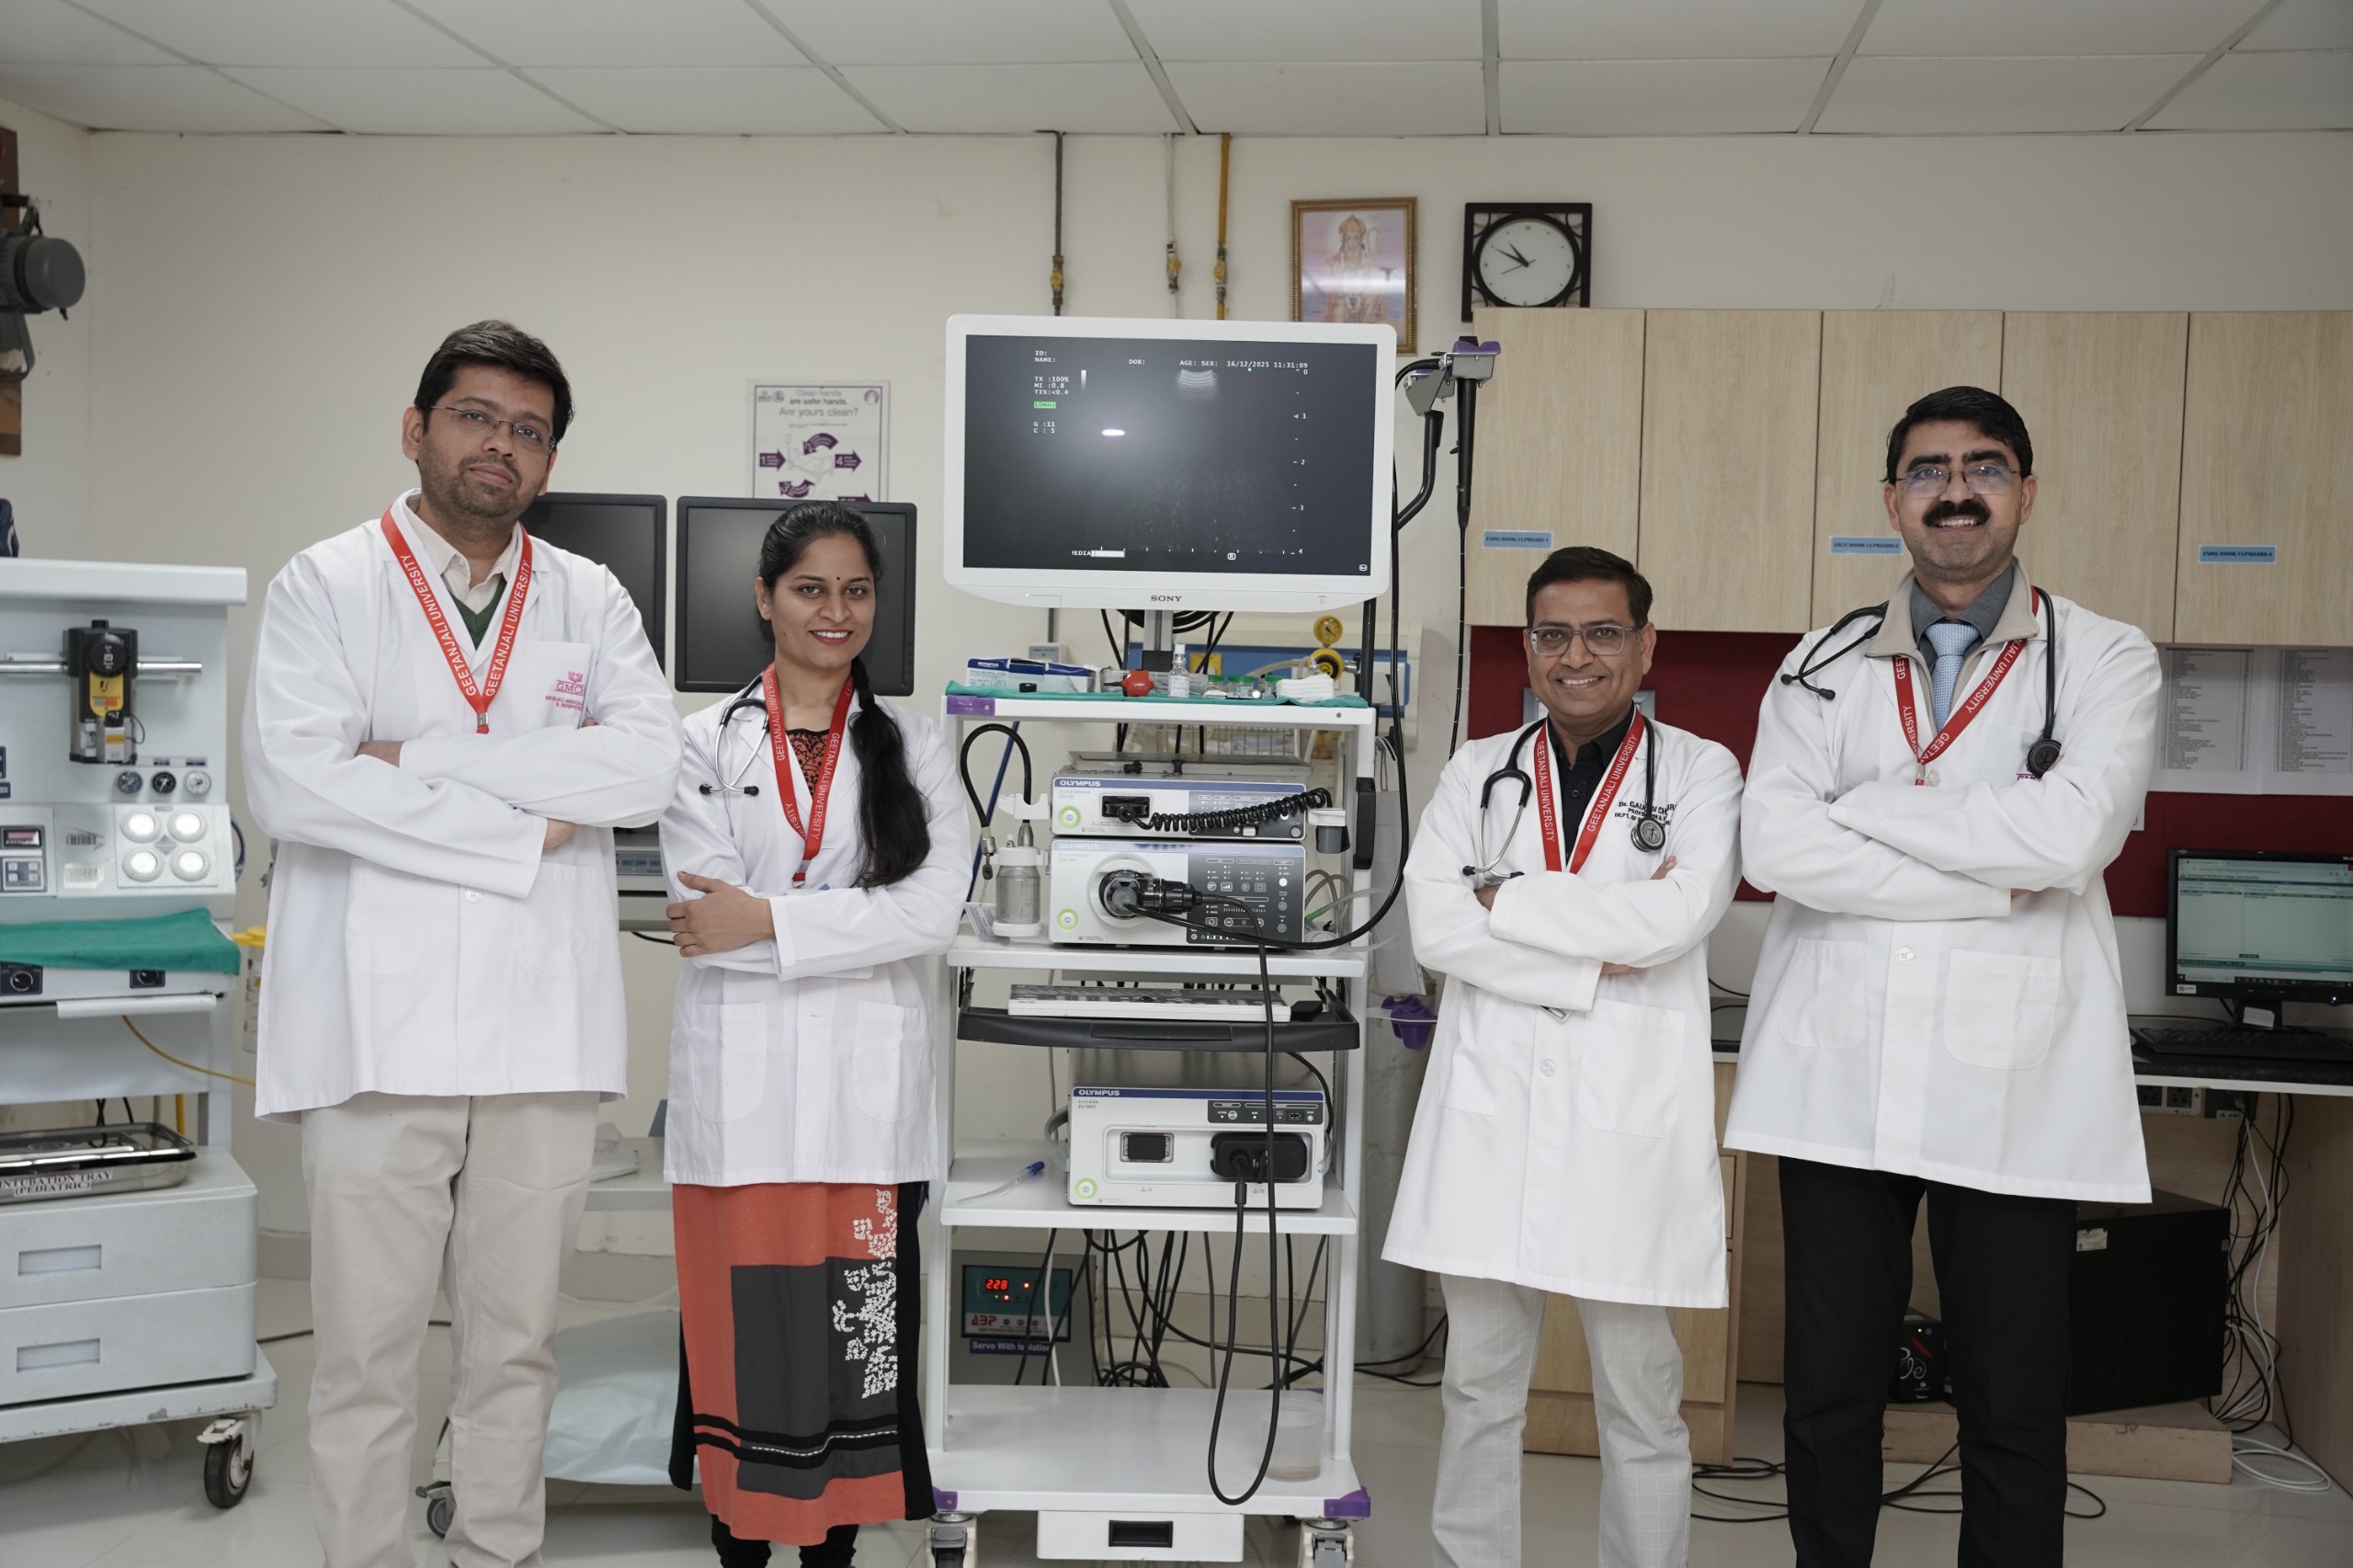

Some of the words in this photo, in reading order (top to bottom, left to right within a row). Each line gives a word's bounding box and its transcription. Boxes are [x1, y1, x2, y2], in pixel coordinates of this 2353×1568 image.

[779, 407, 796, 415] Are
[798, 410, 825, 418] yours
[827, 407, 859, 417] clean?
[819, 389, 842, 397] hands
[835, 455, 844, 466] 4
[780, 483, 790, 493] 3
[399, 553, 443, 620] UNIVERSITY
[485, 623, 516, 698] GEETANJALI
[506, 559, 531, 623] UNIVERSITY
[436, 620, 477, 698] GEETANJALI
[1965, 661, 2007, 714] UNIVERSITY
[770, 710, 786, 762] GEETANJALI
[824, 733, 840, 783] GEETANJALI
[1537, 740, 1549, 789] GEETANJALI
[1586, 778, 1617, 832] GEETANJALI
[1611, 733, 1638, 780] UNIVERSITY
[811, 781, 829, 841] UNIVERSITY
[1540, 790, 1555, 842] UNIVERSITY
[0, 1176, 74, 1188] INTUBATION
[80, 1171, 110, 1182] TRAY
[15, 1181, 90, 1196] (PEDIATRIC)
[985, 1278, 1008, 1290] 228
[972, 1341, 996, 1350] Servo
[997, 1342, 1016, 1350] With
